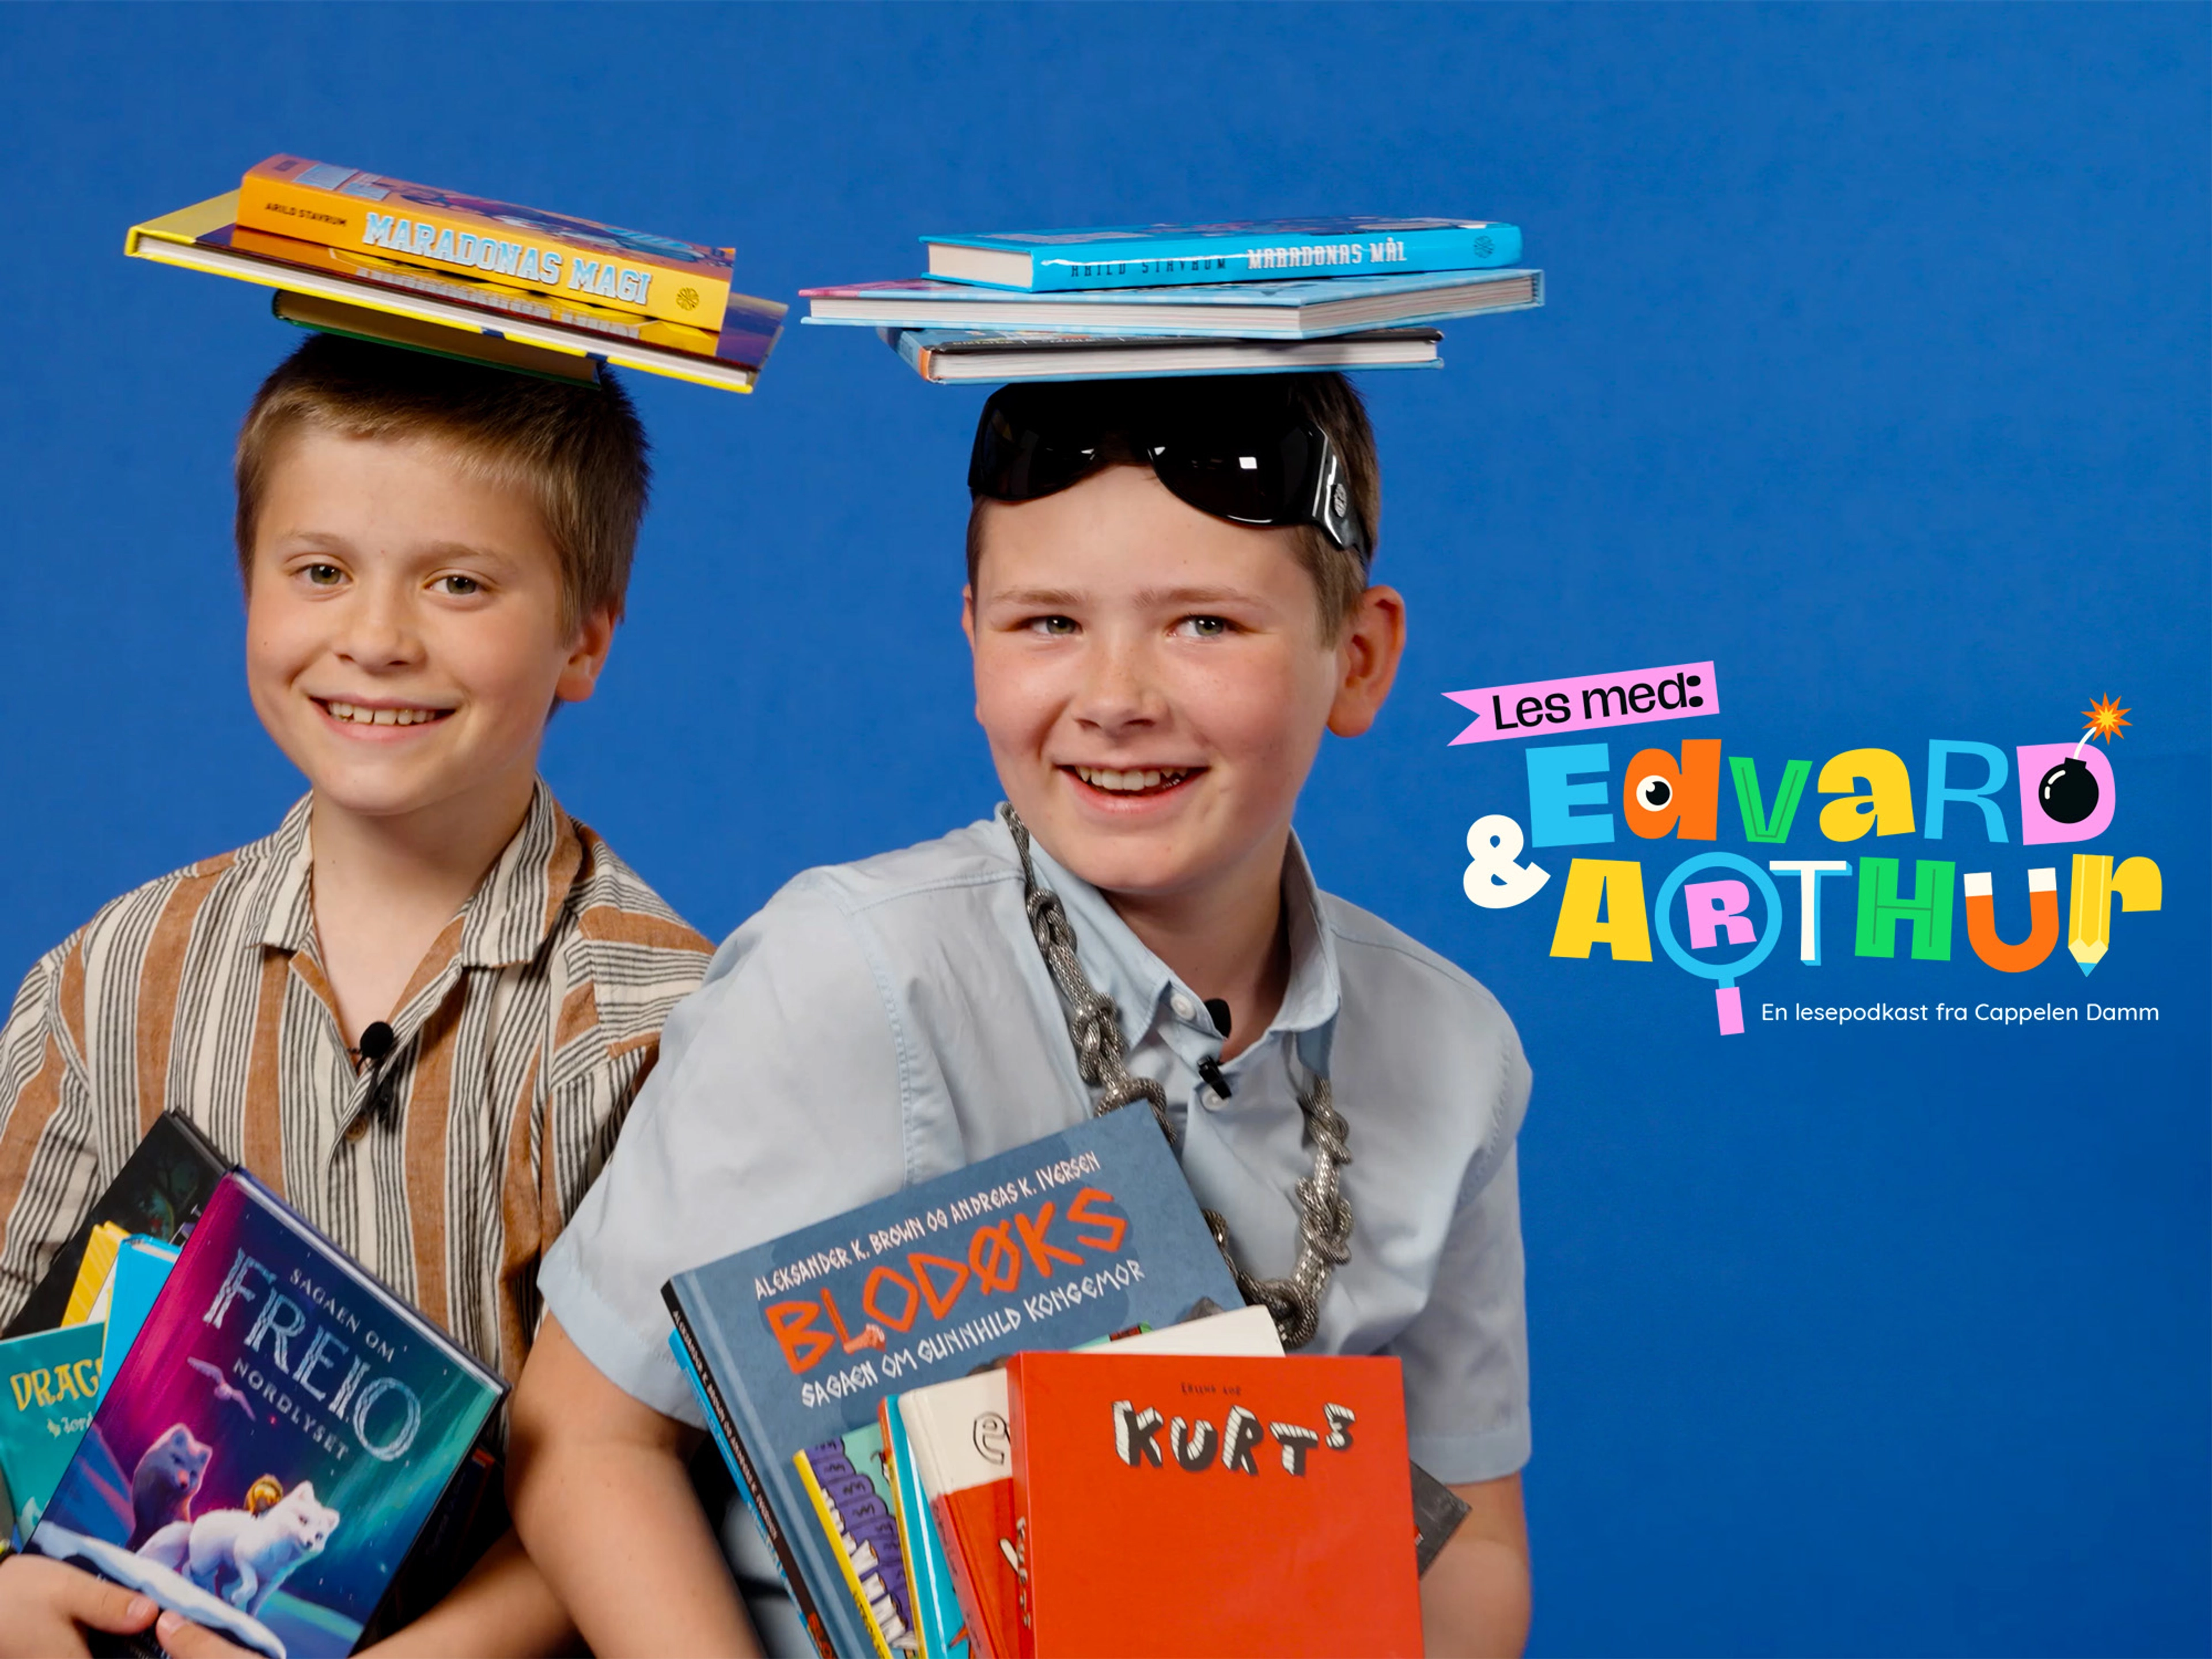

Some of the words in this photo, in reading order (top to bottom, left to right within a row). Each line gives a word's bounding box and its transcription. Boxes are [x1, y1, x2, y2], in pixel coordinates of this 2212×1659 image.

[362, 212, 563, 285] MARADONAS
[568, 259, 652, 305] MAGI
[1247, 244, 1363, 270] MARADONAS
[1370, 237, 1407, 262] MÅL
[753, 1240, 852, 1301] ALEKSANDER
[851, 1239, 870, 1262] K.
[869, 1217, 927, 1252] BROWN
[926, 1208, 949, 1233] OG
[950, 1182, 1018, 1225] ANDREAS
[1017, 1175, 1037, 1199] K.
[1036, 1150, 1101, 1192] IVERSEN
[290, 1268, 362, 1334] SAGAEN
[365, 1331, 396, 1363] OM
[765, 1187, 1127, 1374] BLODØKS
[10, 1357, 103, 1412] DRAG
[203, 1247, 421, 1461] FREIO
[801, 1360, 878, 1409] SAGAEN
[881, 1349, 918, 1379] OM
[917, 1306, 1021, 1365] GUNNHILD
[1024, 1259, 1146, 1323] KONGEMOR
[233, 1357, 350, 1460] NORDLYSET
